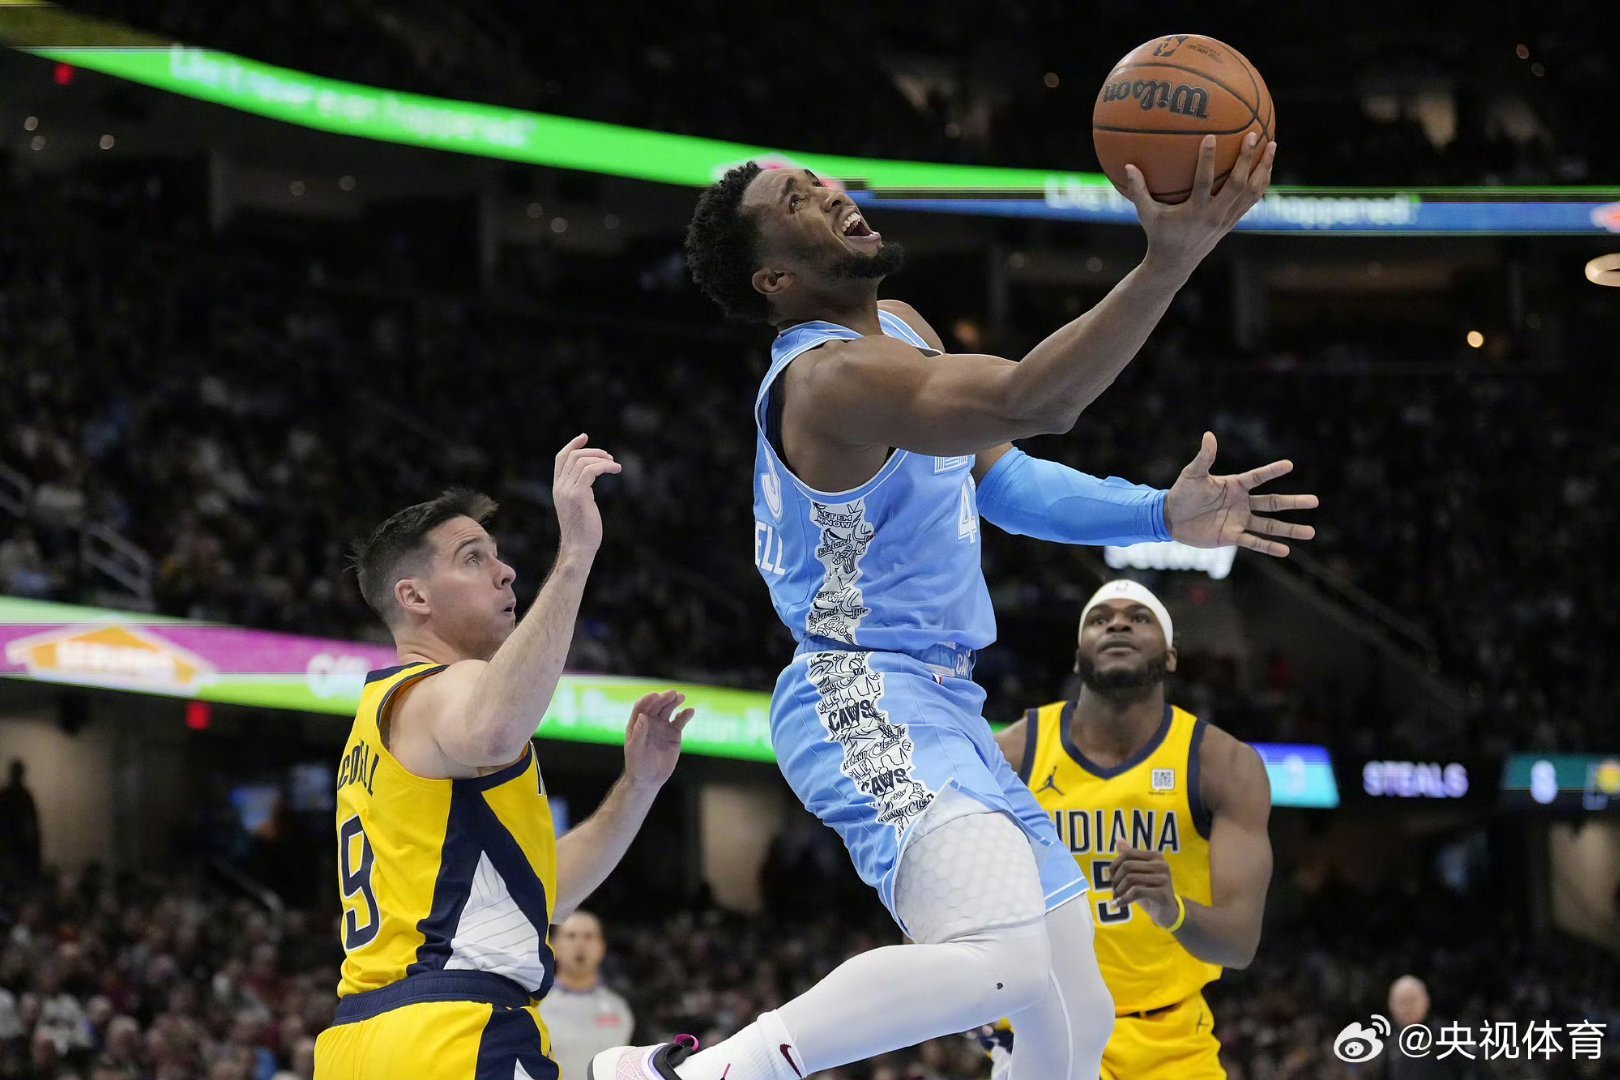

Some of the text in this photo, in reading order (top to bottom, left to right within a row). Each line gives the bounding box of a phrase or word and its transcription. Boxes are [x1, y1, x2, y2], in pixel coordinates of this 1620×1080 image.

[1103, 78, 1211, 120] Wilson
[958, 475, 979, 545] 4
[1055, 809, 1181, 854] DIANA
[340, 815, 380, 953] 9
